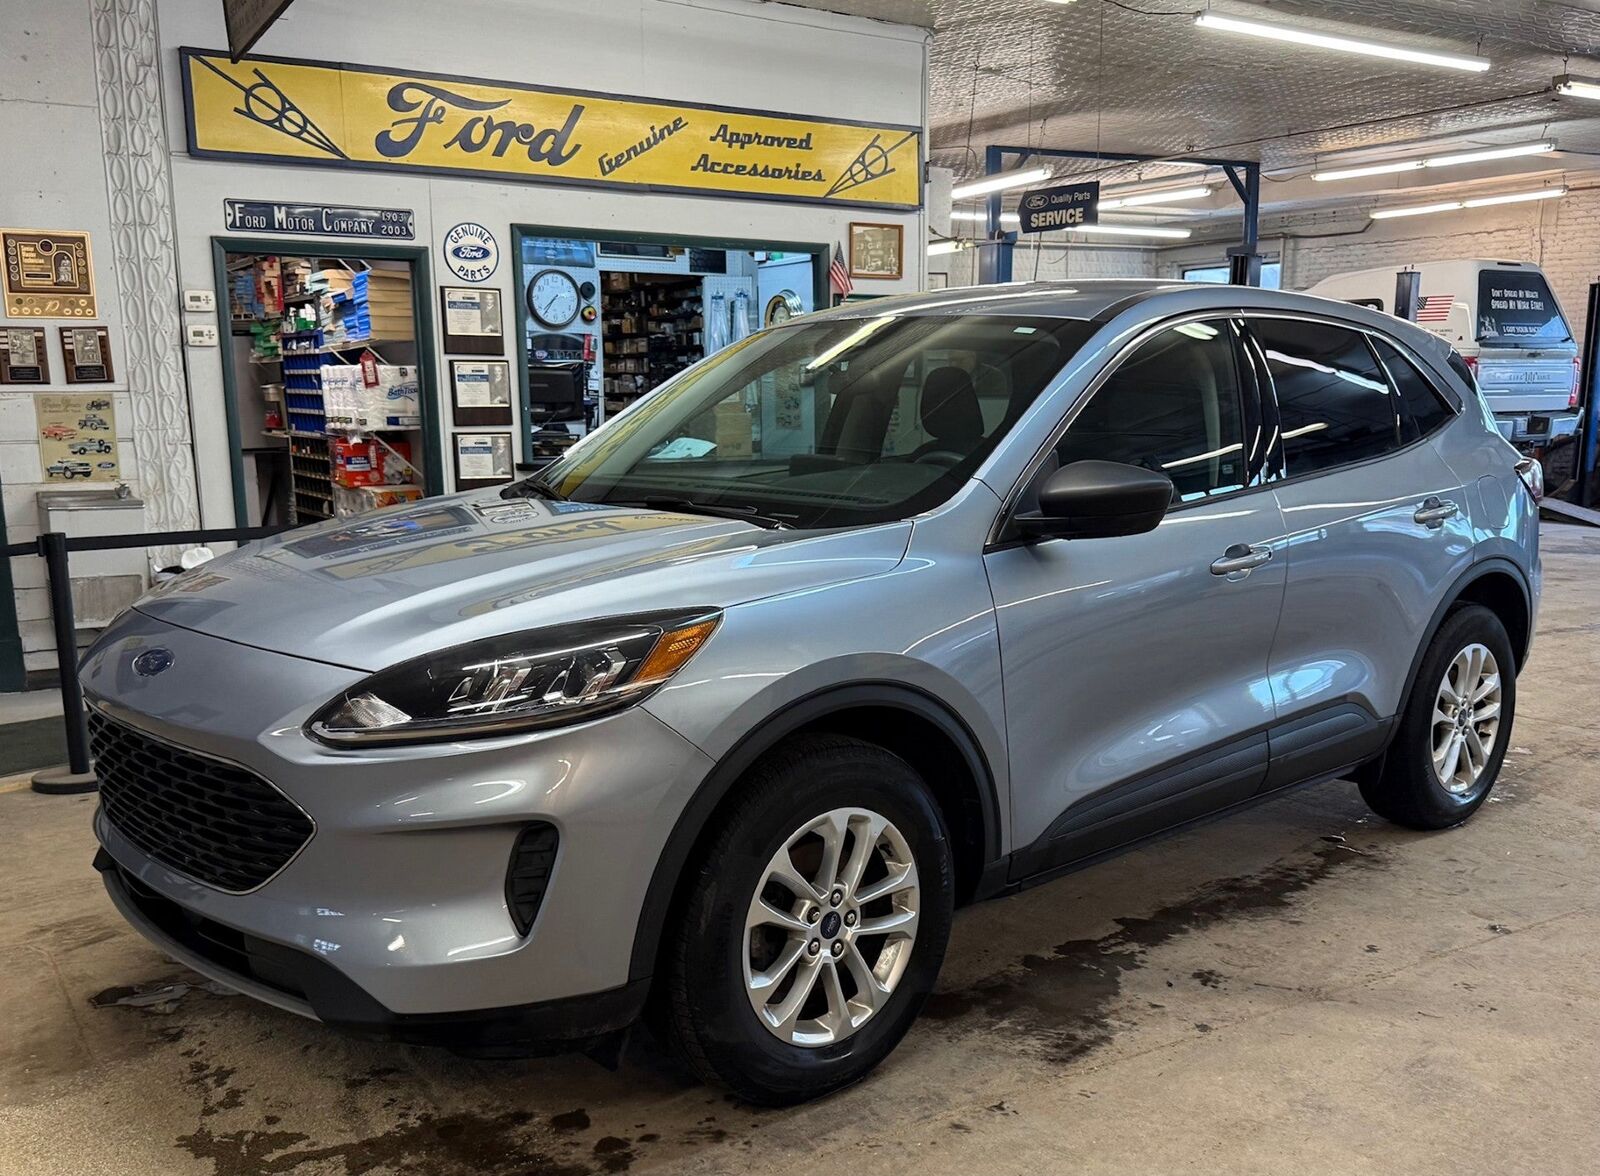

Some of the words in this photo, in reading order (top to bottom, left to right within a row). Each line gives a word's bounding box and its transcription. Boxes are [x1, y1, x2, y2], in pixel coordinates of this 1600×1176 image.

[375, 82, 585, 166] Ford
[598, 116, 688, 176] Genuine
[709, 124, 813, 150] Approved
[690, 154, 826, 182] Accessories
[1050, 193, 1073, 204] Quality
[1073, 191, 1091, 201] Parts
[234, 203, 266, 228] FORD
[273, 206, 315, 231] MOTOR
[322, 207, 375, 233] COMPANY
[381, 211, 404, 222] 1903
[1030, 207, 1084, 228] SERVICE
[381, 225, 407, 236] 2003
[450, 225, 491, 245] GENUINE
[459, 246, 484, 258] Ford
[457, 265, 491, 279] PARTS
